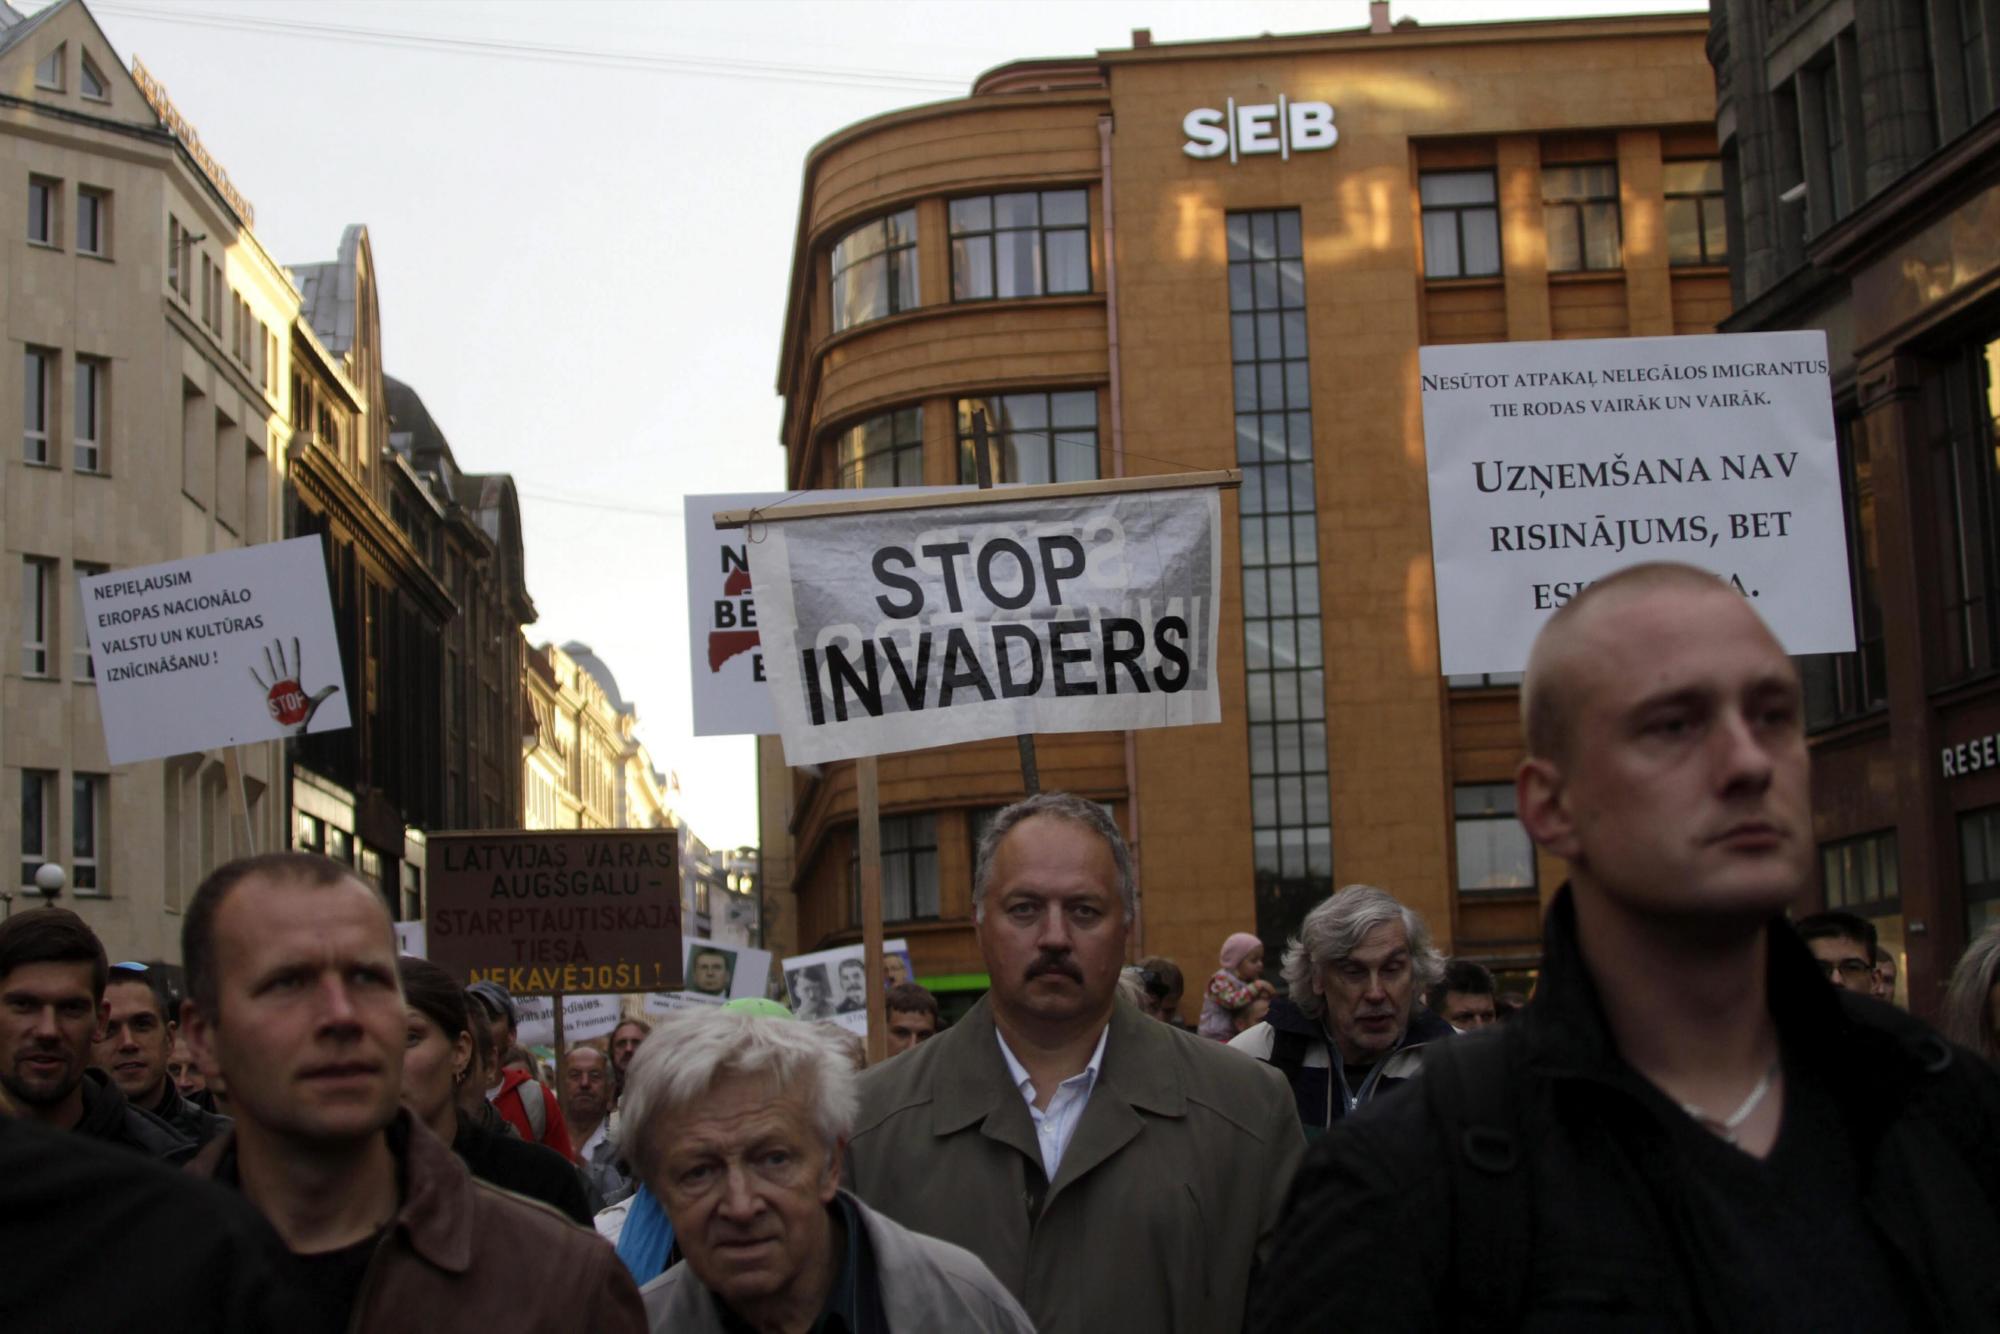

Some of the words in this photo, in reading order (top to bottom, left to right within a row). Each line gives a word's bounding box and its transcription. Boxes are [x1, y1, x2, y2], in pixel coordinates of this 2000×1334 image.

[1182, 95, 1339, 162] SEB
[1421, 371, 1509, 392] NESŪTOT
[1514, 369, 1599, 389] ATPAKAĻ
[1602, 363, 1707, 384] NELEGĀLOS
[1712, 359, 1831, 380] IMIGRANTUS,
[1490, 402, 1518, 418] TIE
[1523, 399, 1586, 417] RODAS
[1590, 396, 1662, 414] VAIRĀK
[1665, 395, 1692, 410] UN
[1696, 391, 1771, 408] VAIRĀK.
[1472, 453, 1711, 498] UZŅEMŠANA
[1721, 452, 1798, 480] NAV
[1490, 514, 1720, 552] RISINĀJUMS,
[1729, 511, 1792, 540] BET
[721, 545, 749, 573] N
[871, 534, 1086, 620] STOP
[94, 571, 192, 600] NEPIEĻAUSIM
[98, 604, 160, 627] EIROPAS
[163, 588, 251, 616] NACIONĀLO
[102, 633, 157, 654] VALSTU
[161, 629, 182, 645] UN
[186, 614, 264, 640] KULTŪRAS
[107, 652, 210, 682] IZNĪCINĀŠANU
[802, 615, 1190, 726] INVADERS
[443, 844, 568, 872] LATVIJAS
[584, 842, 672, 868] VARAS
